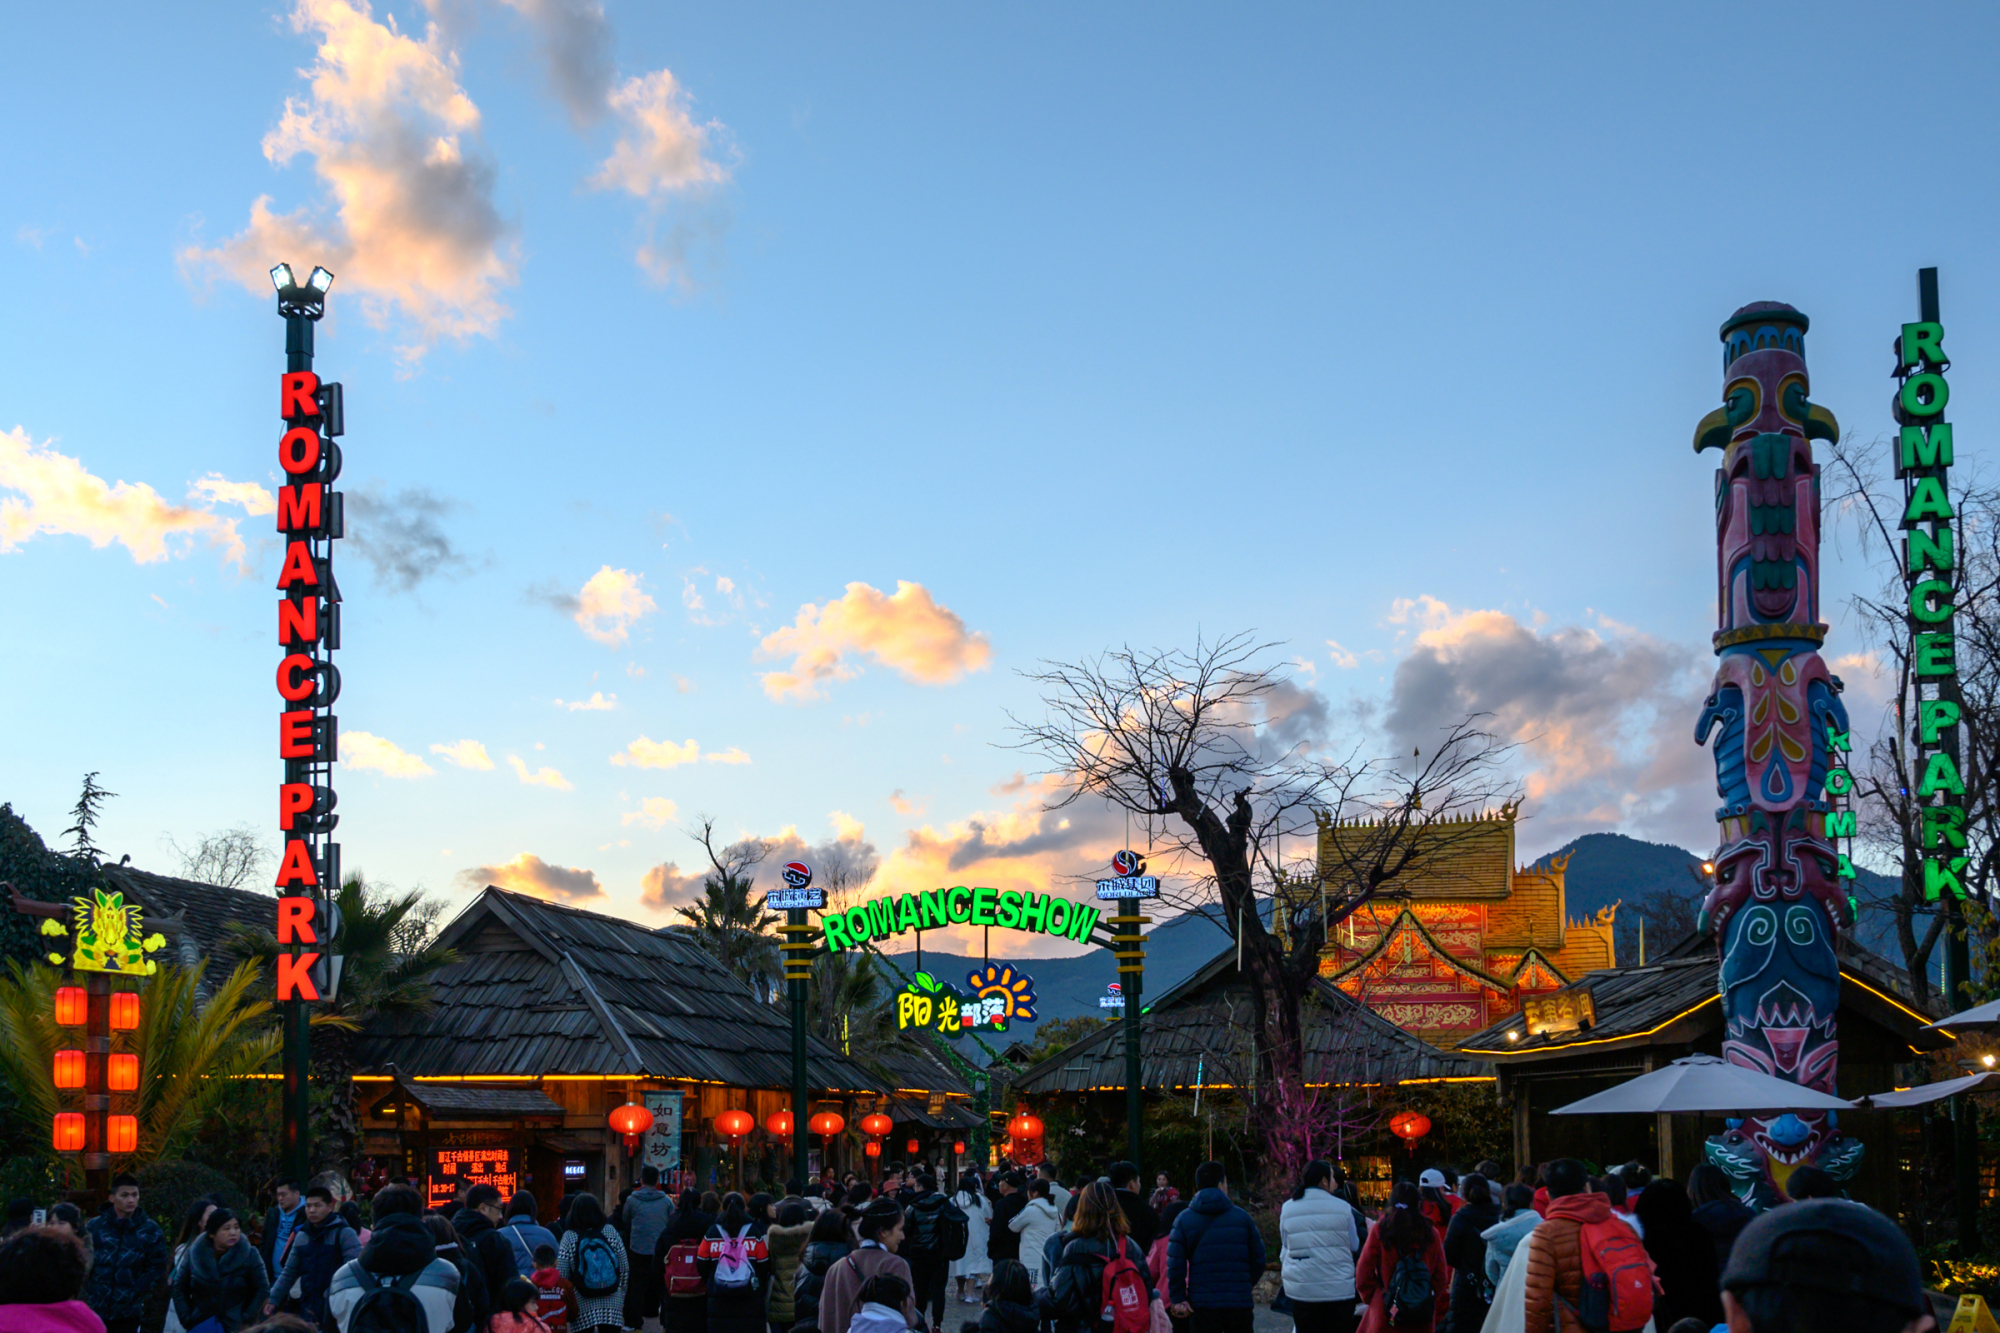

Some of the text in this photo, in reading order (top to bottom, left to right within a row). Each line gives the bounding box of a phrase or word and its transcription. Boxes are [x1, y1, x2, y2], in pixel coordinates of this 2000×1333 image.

[822, 886, 1100, 953] ROMANCESHOW
[650, 1103, 673, 1157] 如意坊
[709, 1240, 757, 1253] REAY
